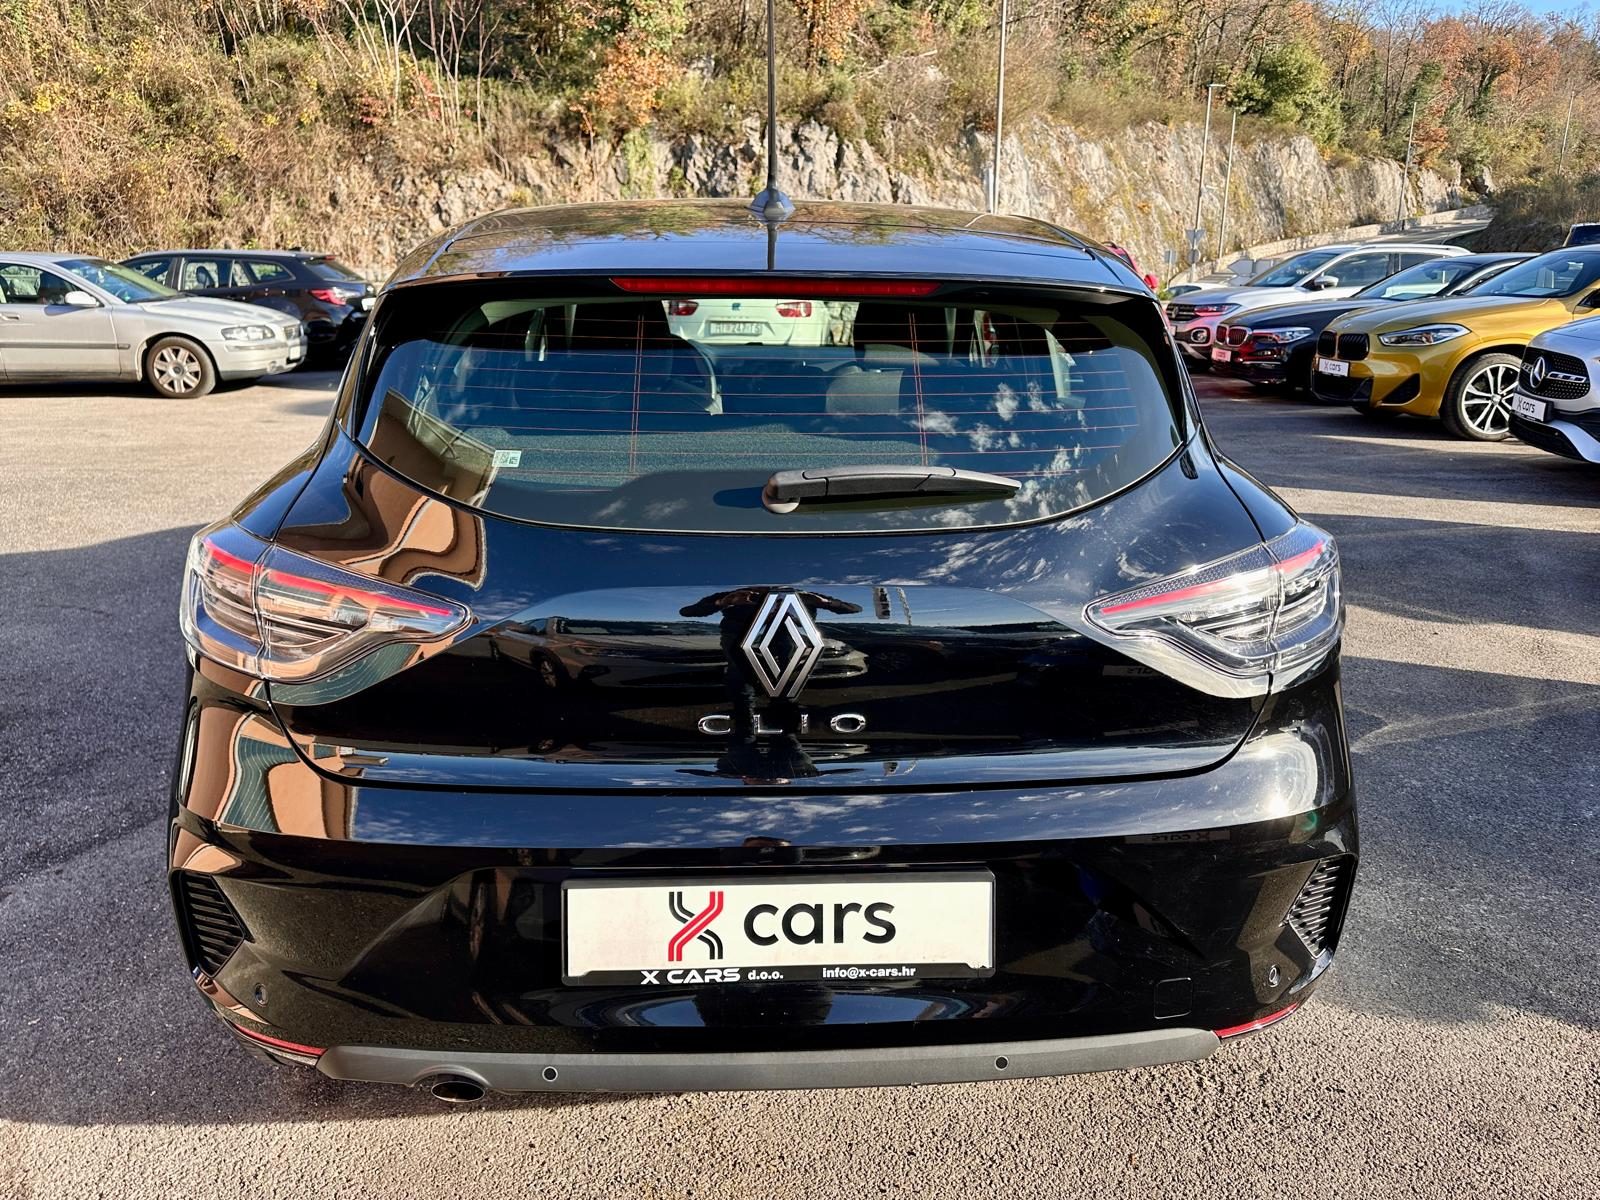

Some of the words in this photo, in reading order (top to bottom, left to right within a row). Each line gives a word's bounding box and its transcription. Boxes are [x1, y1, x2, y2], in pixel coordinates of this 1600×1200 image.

[1522, 401, 1535, 413] cars
[698, 714, 866, 735] CLIO
[743, 902, 897, 946] cars
[640, 970, 660, 985] X
[667, 968, 740, 984] CARS
[748, 970, 784, 980] d.o.o.
[822, 966, 916, 979] info@x-cars.hr
